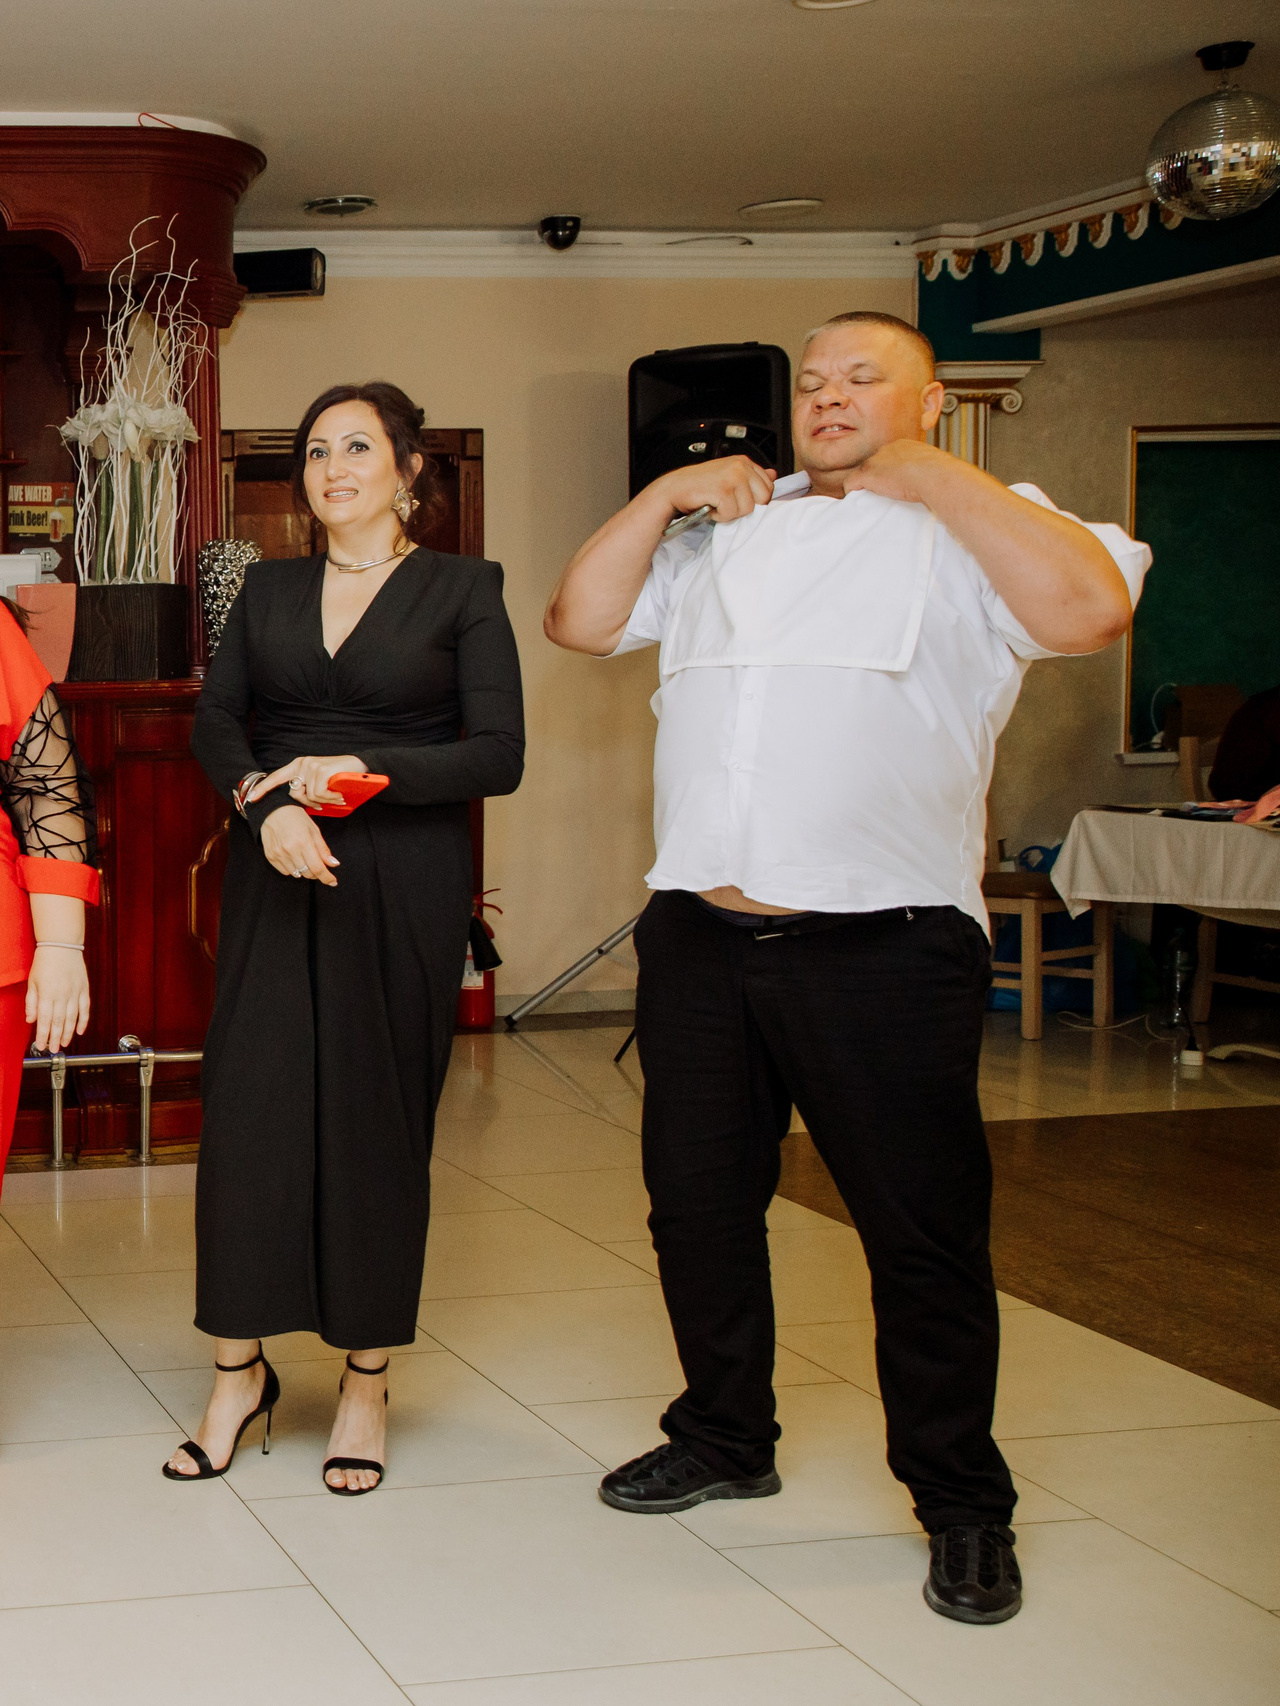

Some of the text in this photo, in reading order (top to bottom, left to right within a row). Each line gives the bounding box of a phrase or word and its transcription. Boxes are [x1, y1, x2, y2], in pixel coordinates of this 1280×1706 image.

[8, 485, 52, 503] AVE WATER
[9, 510, 48, 527] rink Beer!
